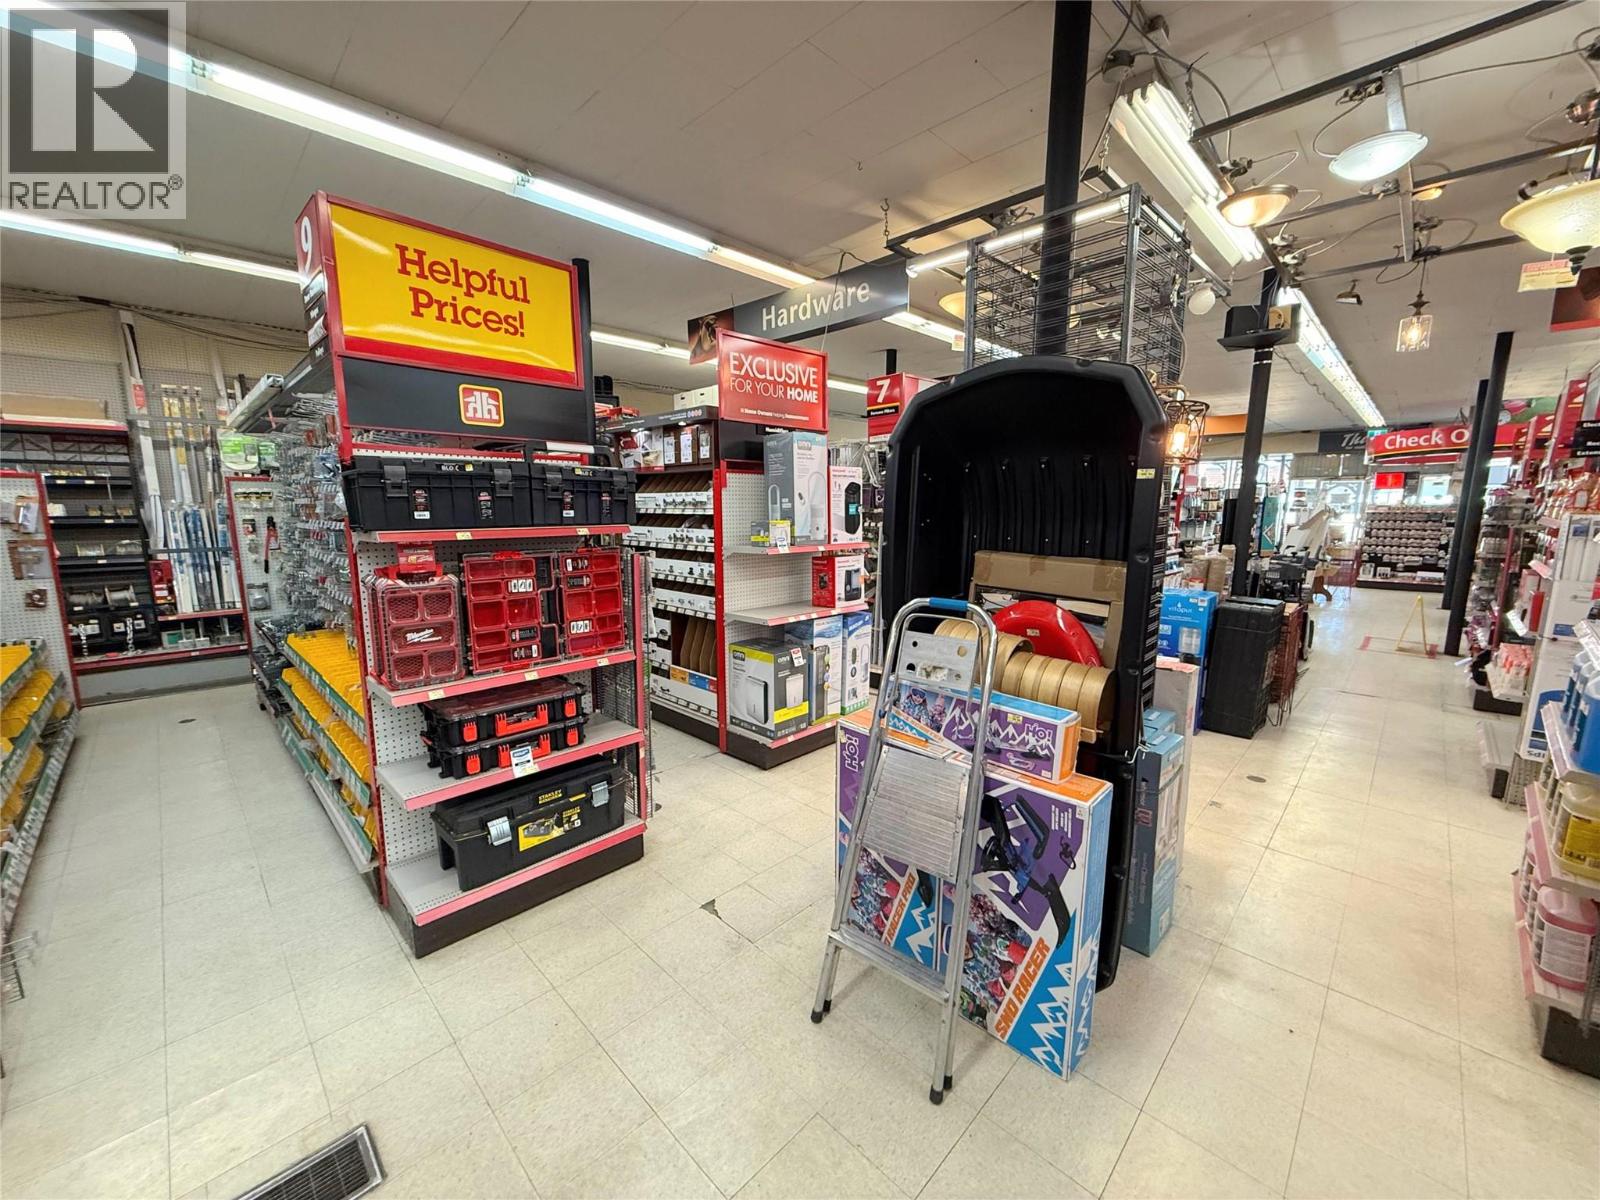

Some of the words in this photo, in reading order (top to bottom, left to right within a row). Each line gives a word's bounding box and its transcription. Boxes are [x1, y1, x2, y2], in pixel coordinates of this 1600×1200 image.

[300, 215, 313, 276] 9
[394, 243, 531, 304] Helpful
[408, 286, 525, 338] Prices!
[761, 281, 871, 332] Hardware
[729, 352, 819, 388] EXCLUSIVE
[729, 377, 752, 394] FOR
[754, 380, 785, 399] YOUR
[786, 386, 819, 404] HOME
[876, 378, 891, 403] 7
[1384, 431, 1443, 450] Check
[901, 871, 917, 901] PRO
[994, 997, 1020, 1041] SNO
[1012, 935, 1051, 1006] RACER
